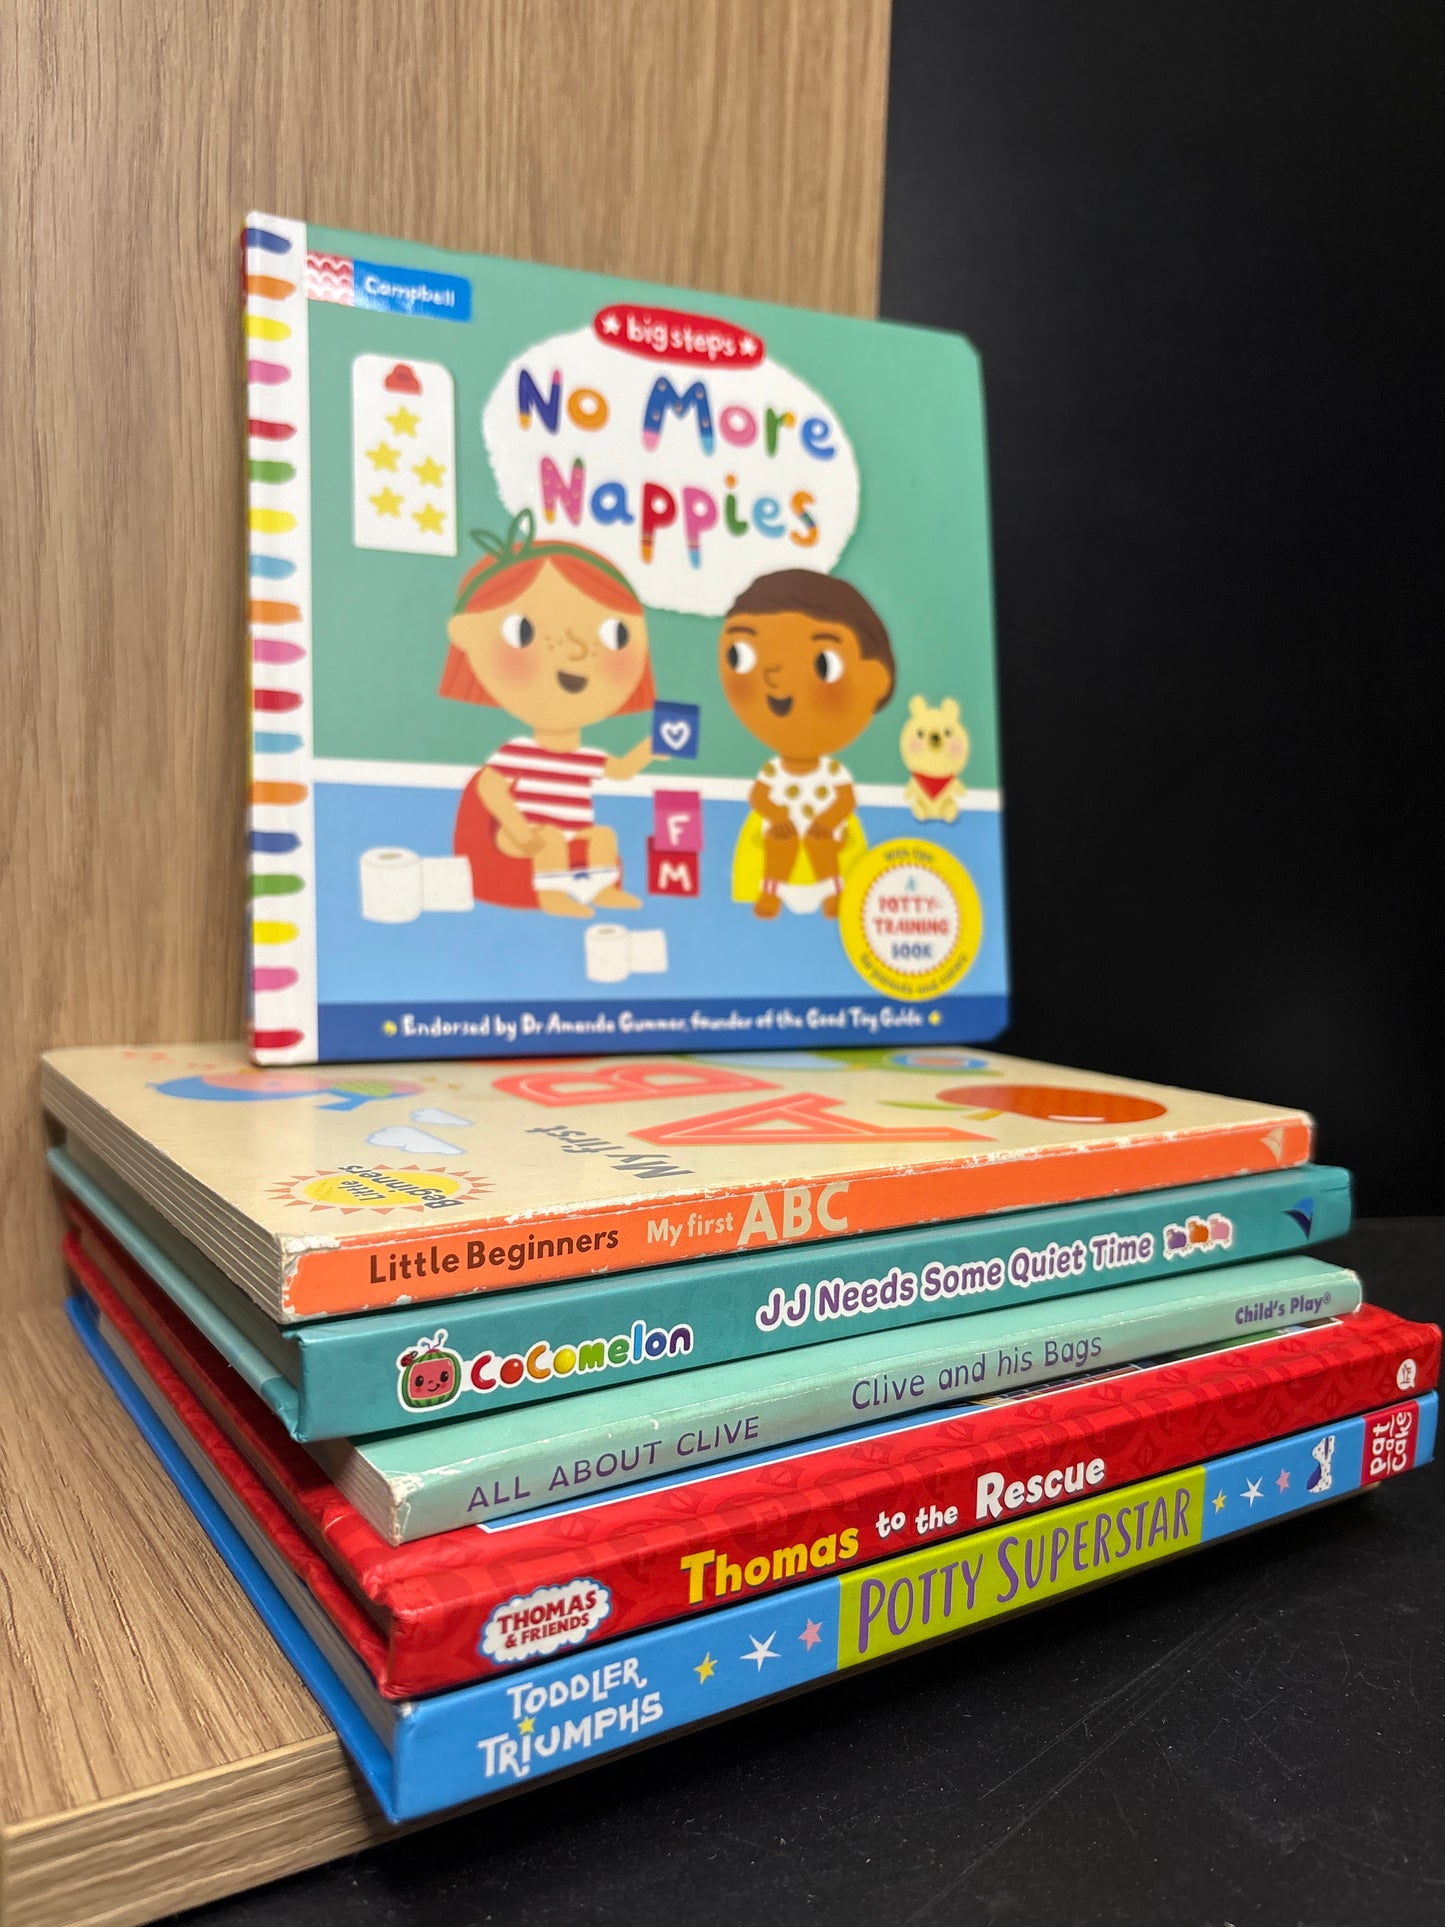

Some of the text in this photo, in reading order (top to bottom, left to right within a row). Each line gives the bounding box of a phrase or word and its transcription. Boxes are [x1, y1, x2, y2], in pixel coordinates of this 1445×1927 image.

[363, 275, 456, 307] Campbell
[626, 313, 736, 360] big steps
[518, 369, 836, 460] No More
[540, 456, 819, 570] Nappies
[667, 814, 690, 846] F
[658, 861, 692, 891] M
[873, 918, 950, 935] TRAINING
[403, 1012, 490, 1037] Endorsed
[493, 1012, 517, 1041] by
[520, 1011, 544, 1034] Dr
[545, 1011, 615, 1034] Amanda
[691, 1008, 751, 1031] founder
[755, 1007, 775, 1029] of
[776, 1007, 803, 1029] the
[805, 1006, 847, 1029] Good
[848, 1005, 878, 1034] Toy
[879, 1005, 923, 1028] Guide
[628, 1092, 996, 1146] A
[524, 1123, 695, 1180] My first
[338, 1165, 465, 1209] Beginners
[338, 1180, 387, 1201] Little
[369, 1182, 850, 1285] Little Beginners My first ABC
[760, 1235, 1152, 1326] JJ Needs Some Quiet Time
[1235, 1300, 1285, 1324] Child's
[852, 1335, 1103, 1411] Clive and his Bags
[467, 1416, 760, 1512] ALL ABOUT CLIVE
[680, 1457, 1106, 1604] Thomas to the Rescue
[858, 1487, 1192, 1653] POTTY SUPERSTAR
[497, 1589, 597, 1635] THOMAS
[504, 1613, 590, 1649] & FRIENDS
[508, 1656, 648, 1720] TODDLER
[477, 1691, 664, 1778] TRIUMPHS
